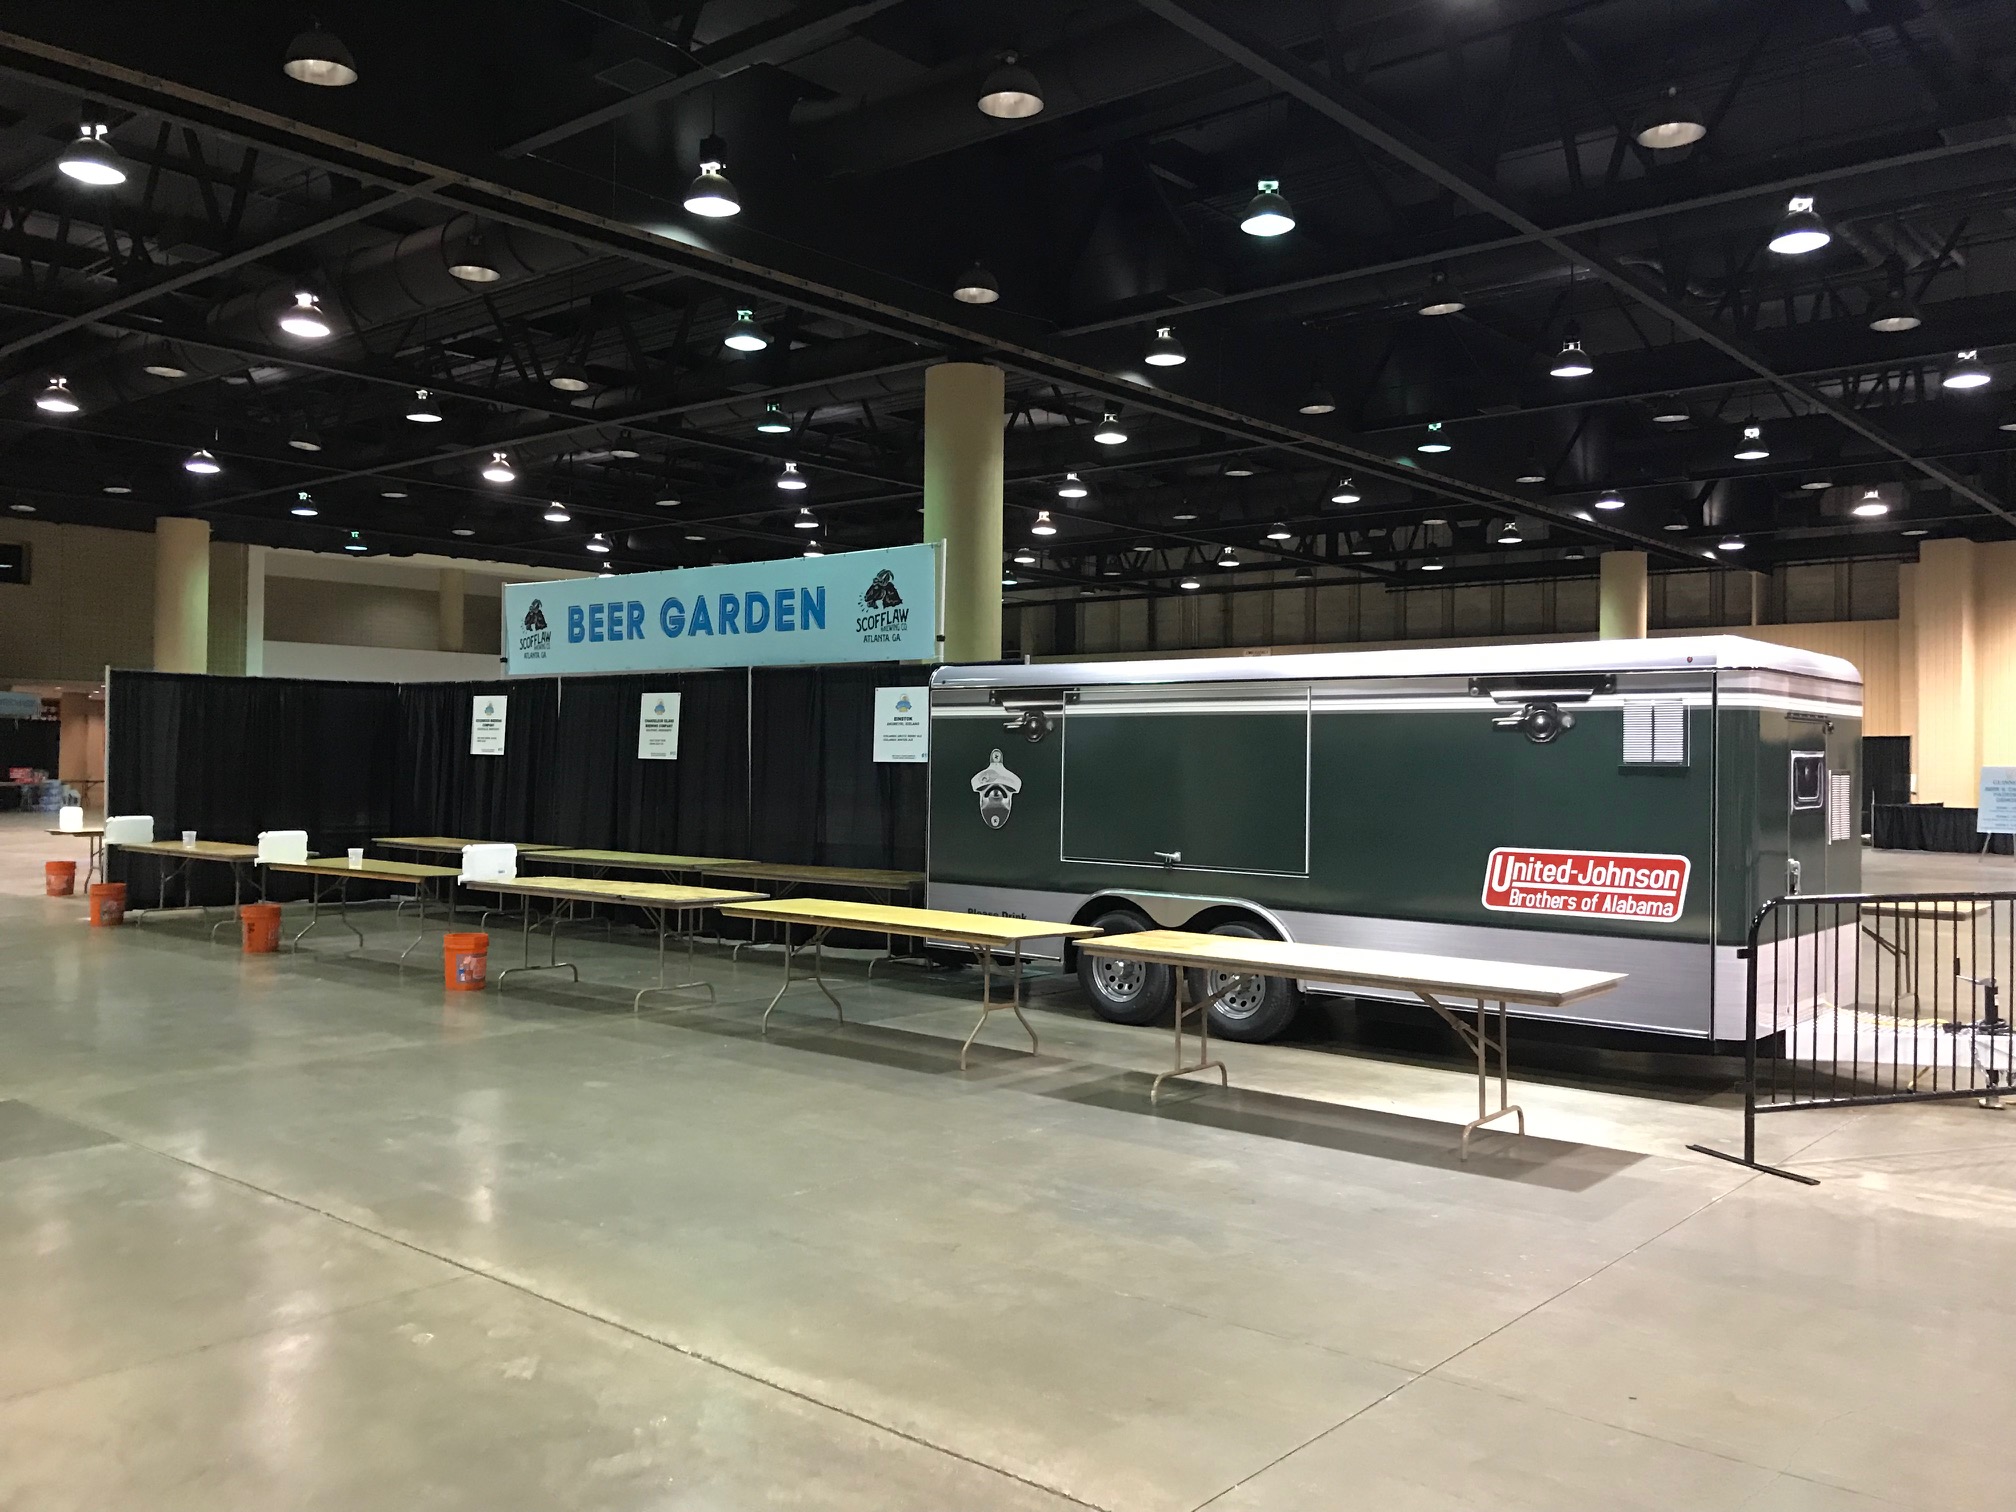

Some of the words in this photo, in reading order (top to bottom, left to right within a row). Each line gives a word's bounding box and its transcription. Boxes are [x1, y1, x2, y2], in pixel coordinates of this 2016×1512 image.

[568, 601, 645, 643] BEER
[660, 586, 826, 638] GARDEN
[856, 608, 909, 632] SCOFFLAW
[519, 631, 552, 650] SCOFFLAW
[891, 633, 901, 642] GA
[1491, 855, 1680, 893] United-Johnson
[1509, 888, 1577, 910] Brothers
[1581, 896, 1598, 911] of
[1602, 894, 1674, 917] Alabama
[1001, 911, 1027, 919] Drink
